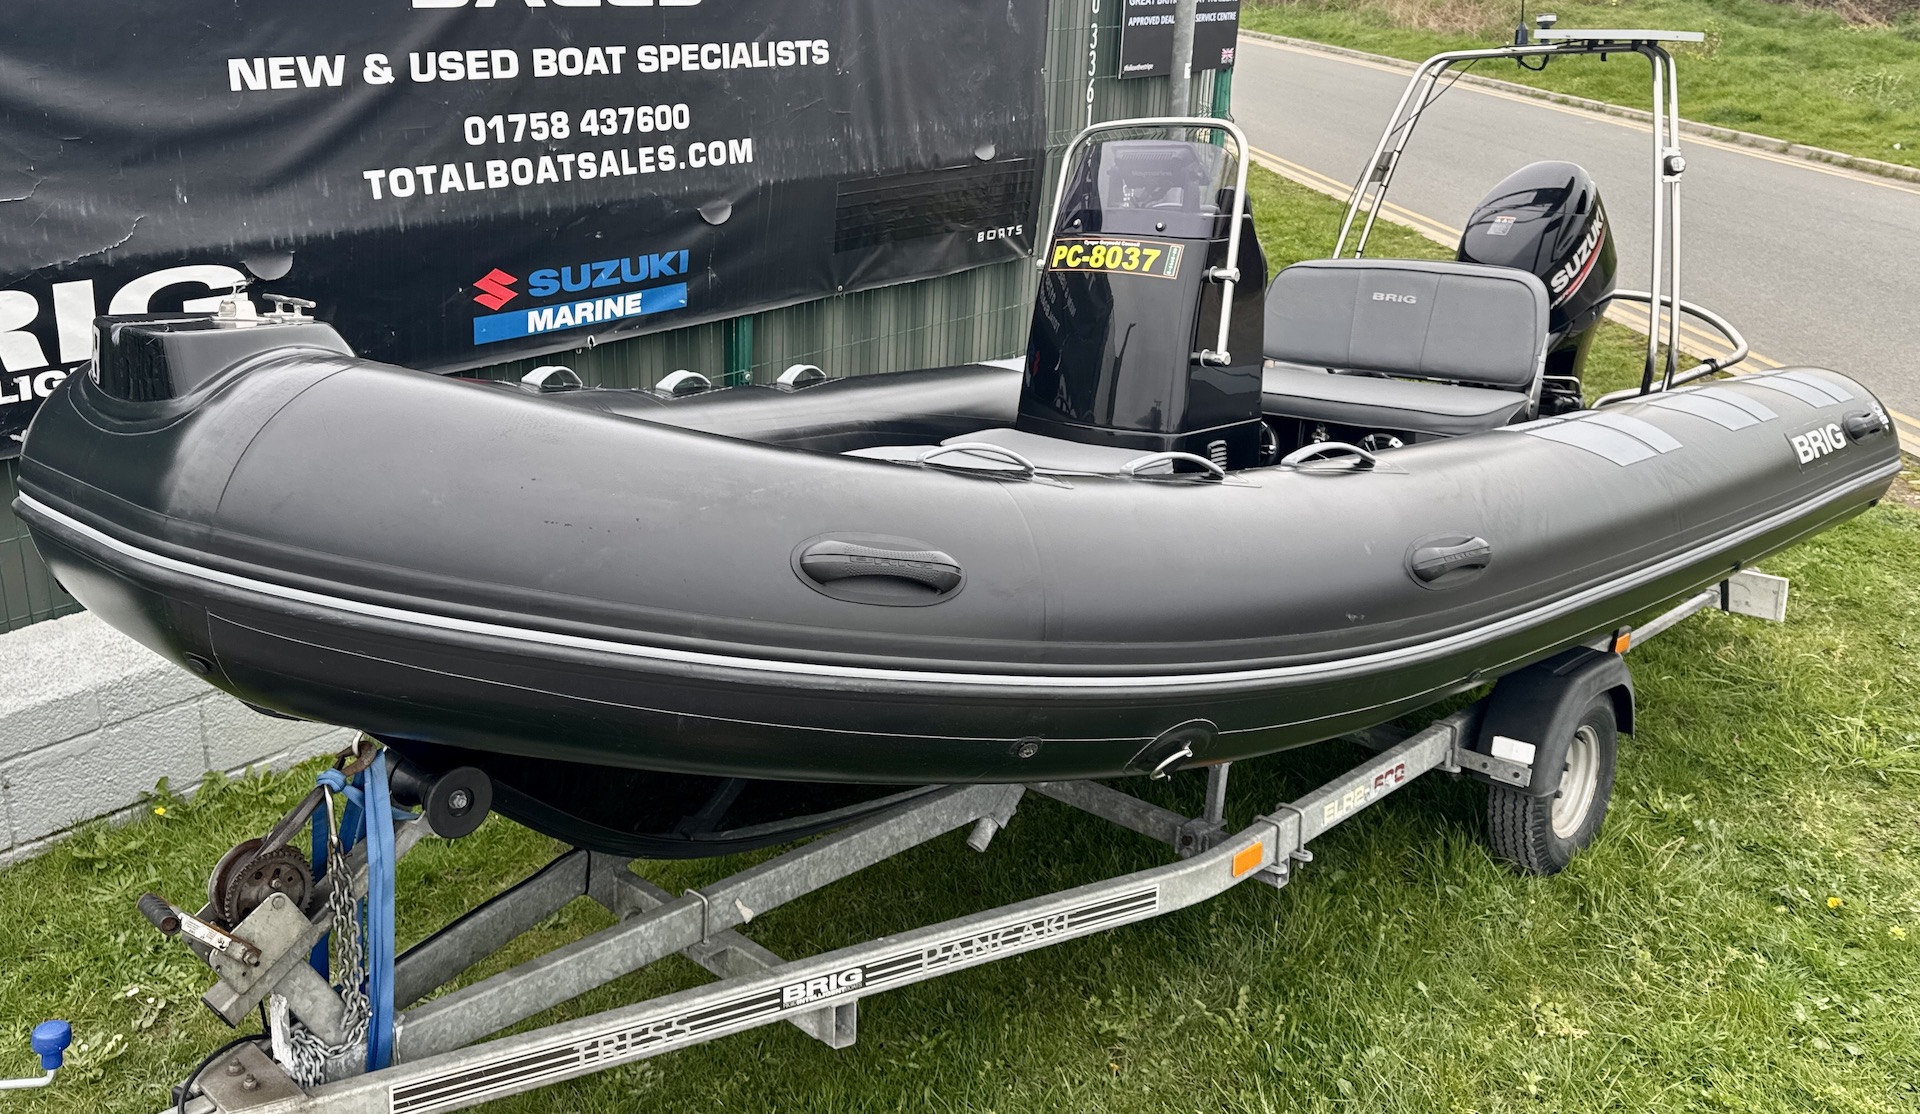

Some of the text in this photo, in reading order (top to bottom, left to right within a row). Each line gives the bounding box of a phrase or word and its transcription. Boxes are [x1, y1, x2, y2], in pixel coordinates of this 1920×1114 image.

[1128, 12, 1237, 26] APPROVED DEAL SERVICE CENTRE
[228, 40, 830, 91] NEW & USED BOAT SPECIALISTS
[464, 104, 690, 146] 01758 437600
[363, 138, 753, 200] TOTALBOATSALES.COM
[977, 225, 1023, 242] BOATS
[1550, 205, 1604, 294] SUZUKI
[528, 249, 689, 297] SUZUKI
[1052, 245, 1161, 272] PC-8037
[527, 293, 642, 333] MARINE
[1372, 292, 1417, 304] BRIG
[1791, 423, 1847, 464] BRIG
[783, 968, 863, 1003] BRIG
